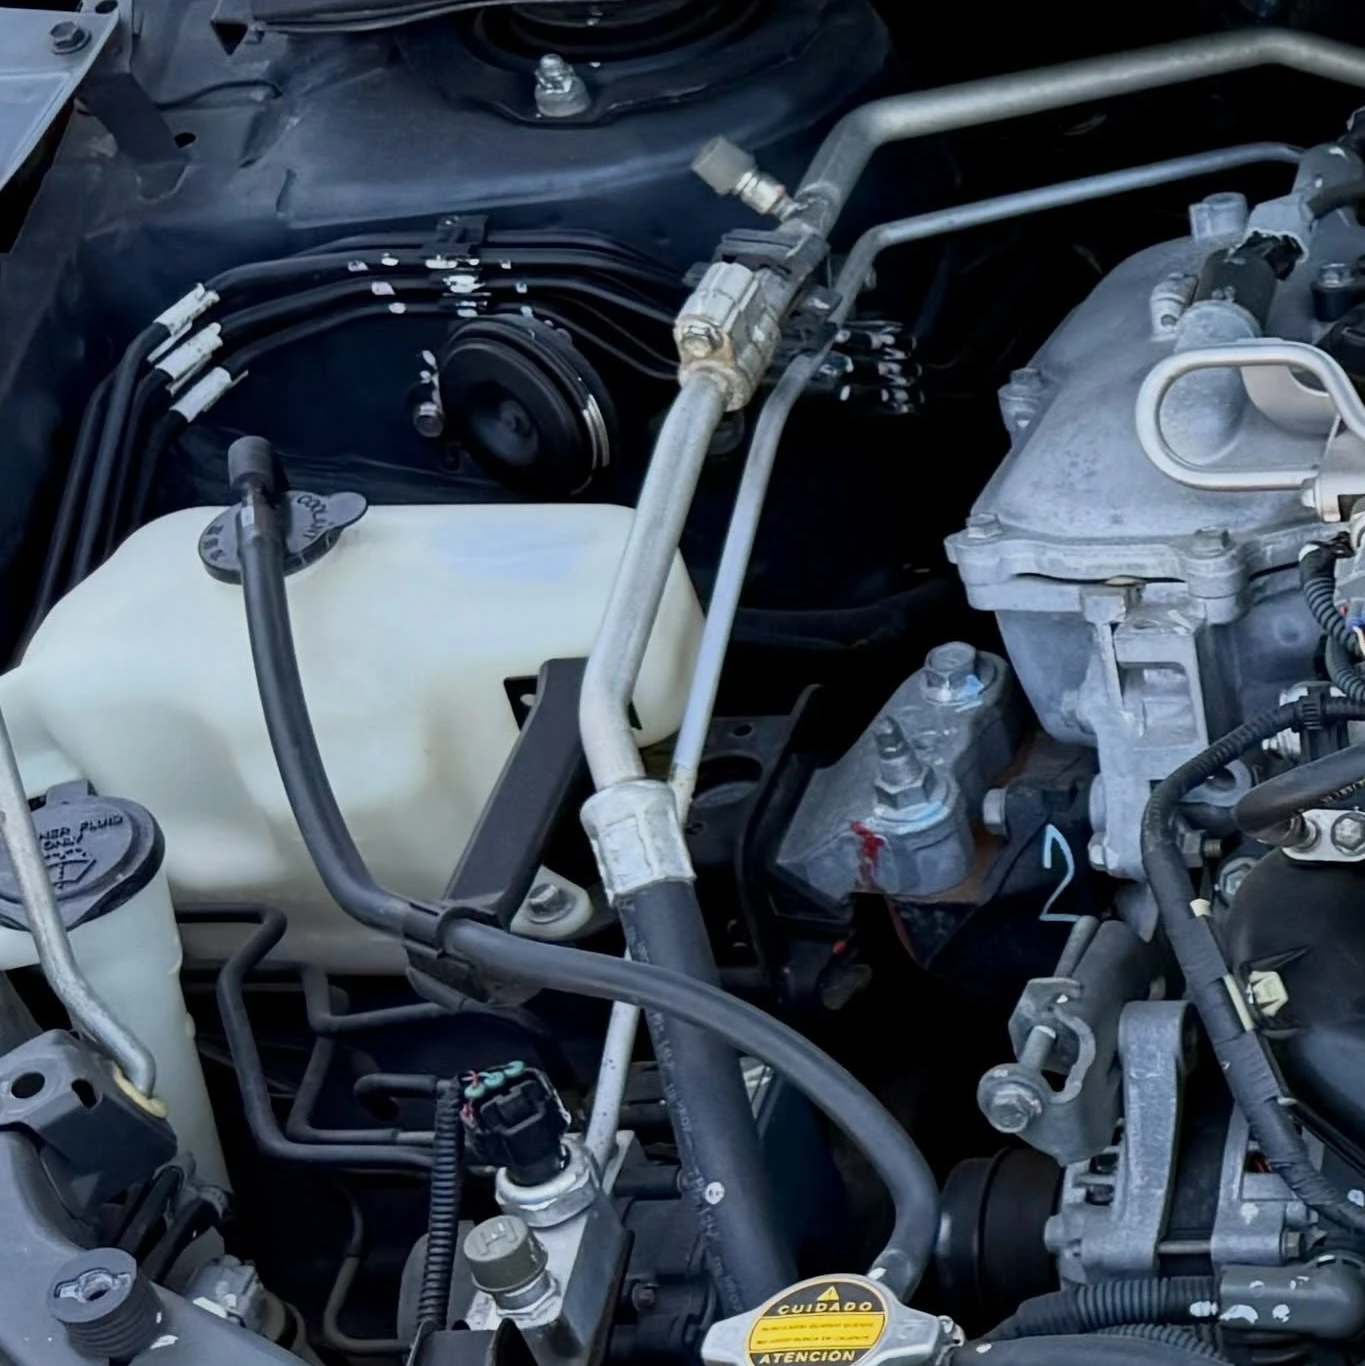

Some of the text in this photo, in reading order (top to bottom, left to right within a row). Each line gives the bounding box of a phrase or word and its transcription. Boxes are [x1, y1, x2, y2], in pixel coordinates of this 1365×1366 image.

[1039, 823, 1081, 922] 2
[777, 1301, 873, 1314] CUIDADO
[759, 1349, 856, 1364] ATENCIÓN
